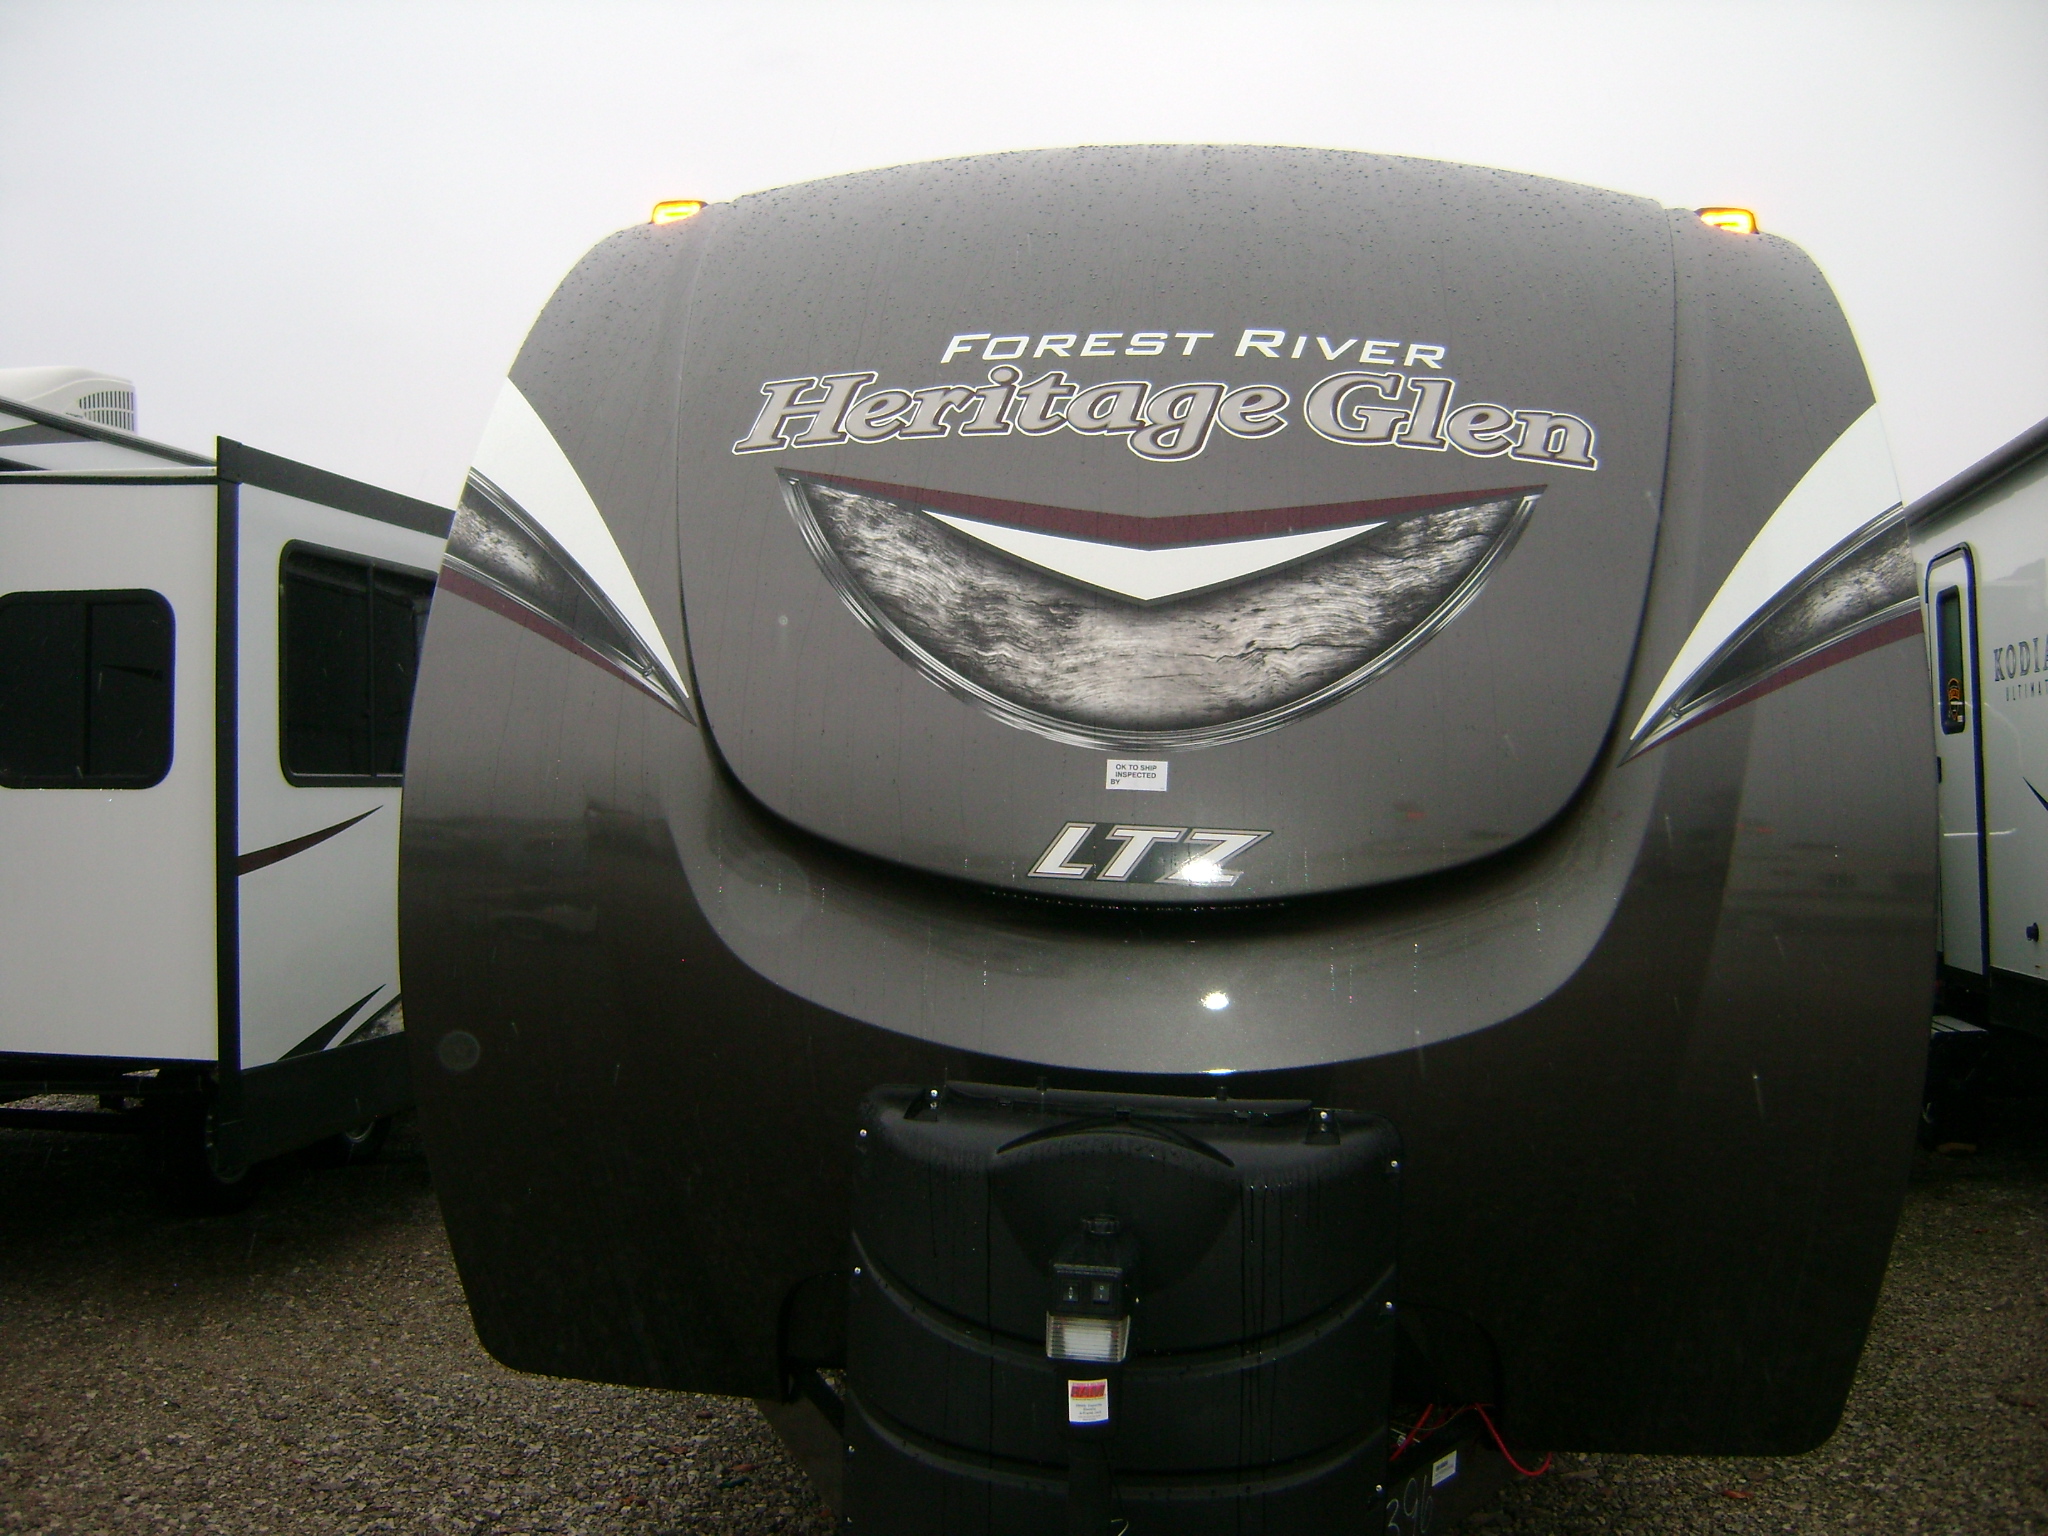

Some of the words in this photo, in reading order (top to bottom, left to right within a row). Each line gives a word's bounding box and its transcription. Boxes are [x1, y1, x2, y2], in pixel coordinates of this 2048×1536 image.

[940, 332, 1214, 364] FOREST
[1234, 329, 1446, 369] RIVER
[732, 364, 1290, 462] Heritage
[1303, 370, 1599, 472] Glen
[1115, 771, 1156, 779] INSPECTED
[1027, 821, 1273, 887] LTZ
